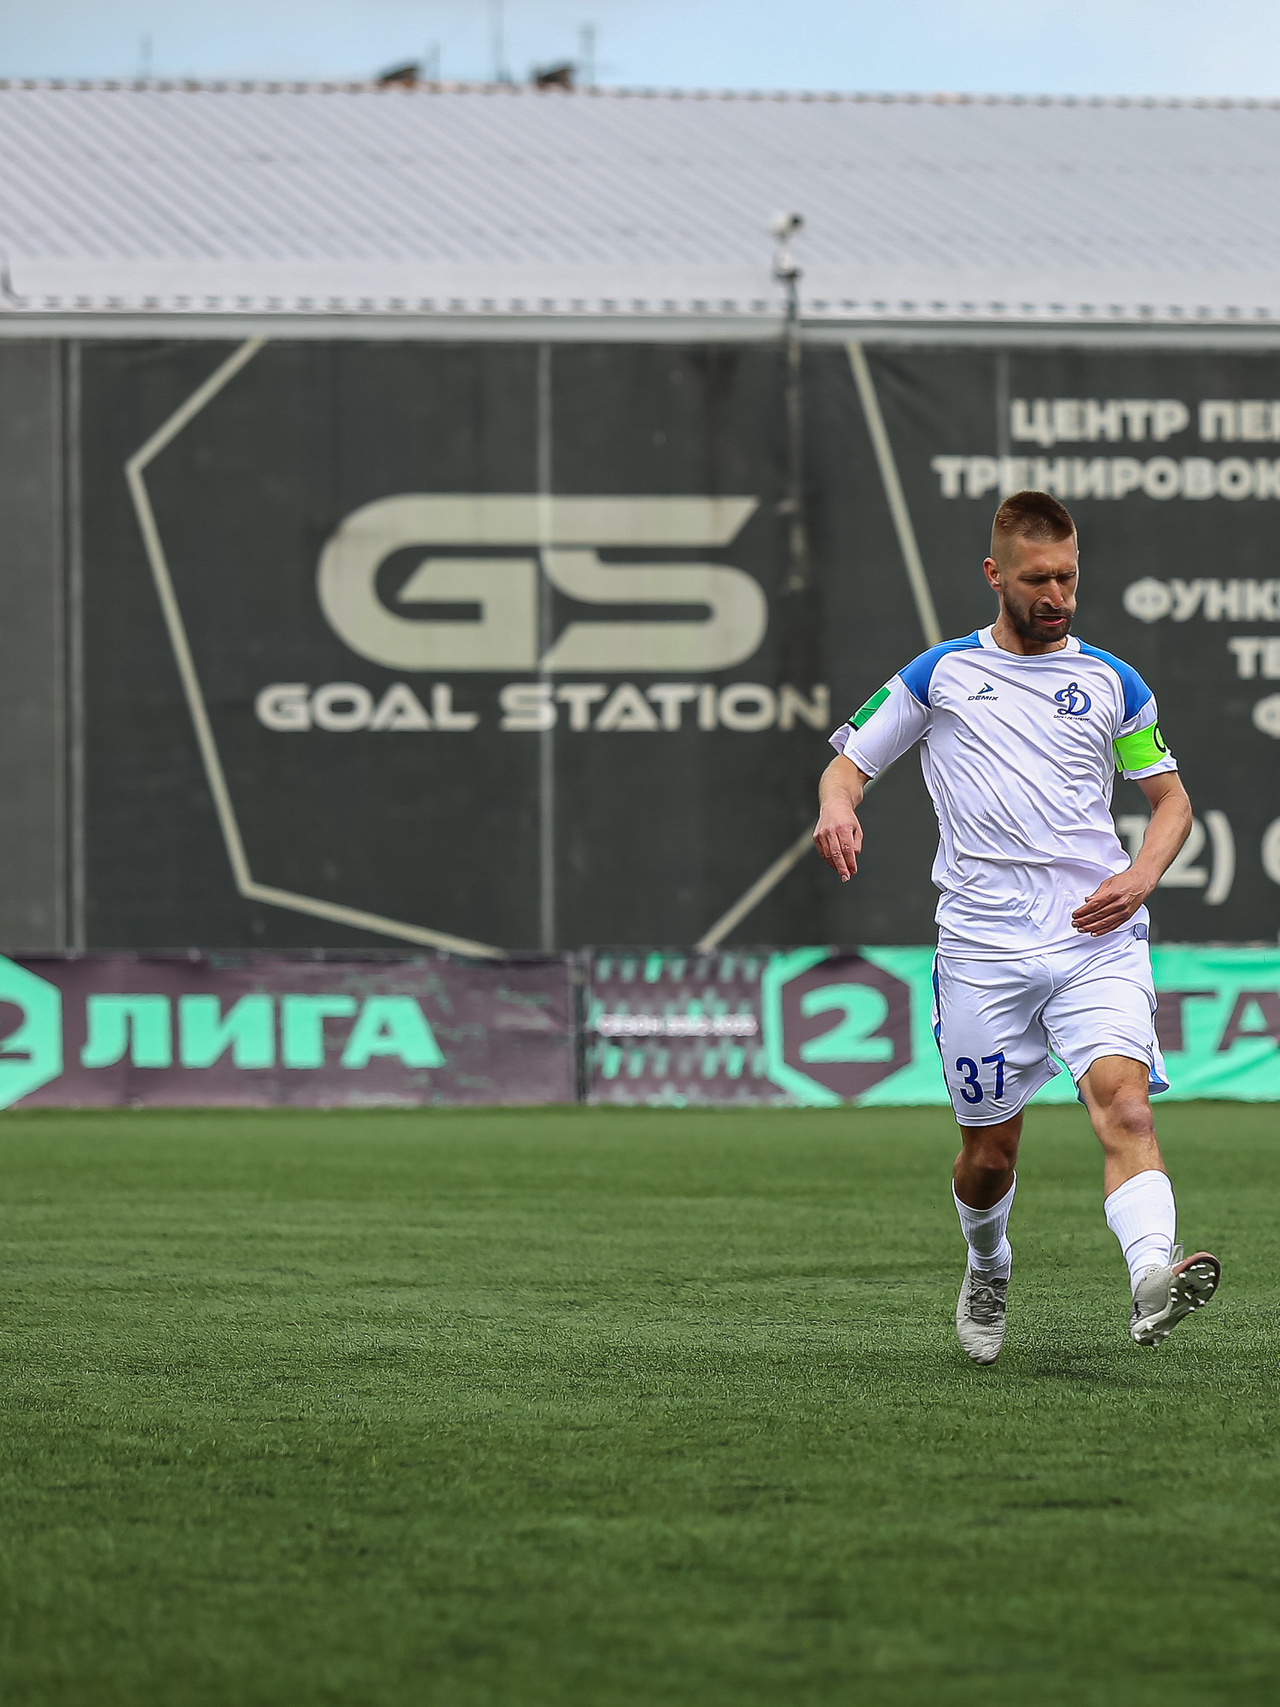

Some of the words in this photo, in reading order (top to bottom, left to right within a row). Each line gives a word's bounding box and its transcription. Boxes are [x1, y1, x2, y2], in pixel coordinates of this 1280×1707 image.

[1010, 398, 1190, 448] ЦЕНТР
[316, 493, 768, 672] GS
[255, 682, 480, 732] GOAL
[500, 683, 831, 732] STATION
[81, 993, 446, 1069] ЛИГА
[800, 981, 895, 1064] 2
[956, 1051, 1005, 1104] 37
